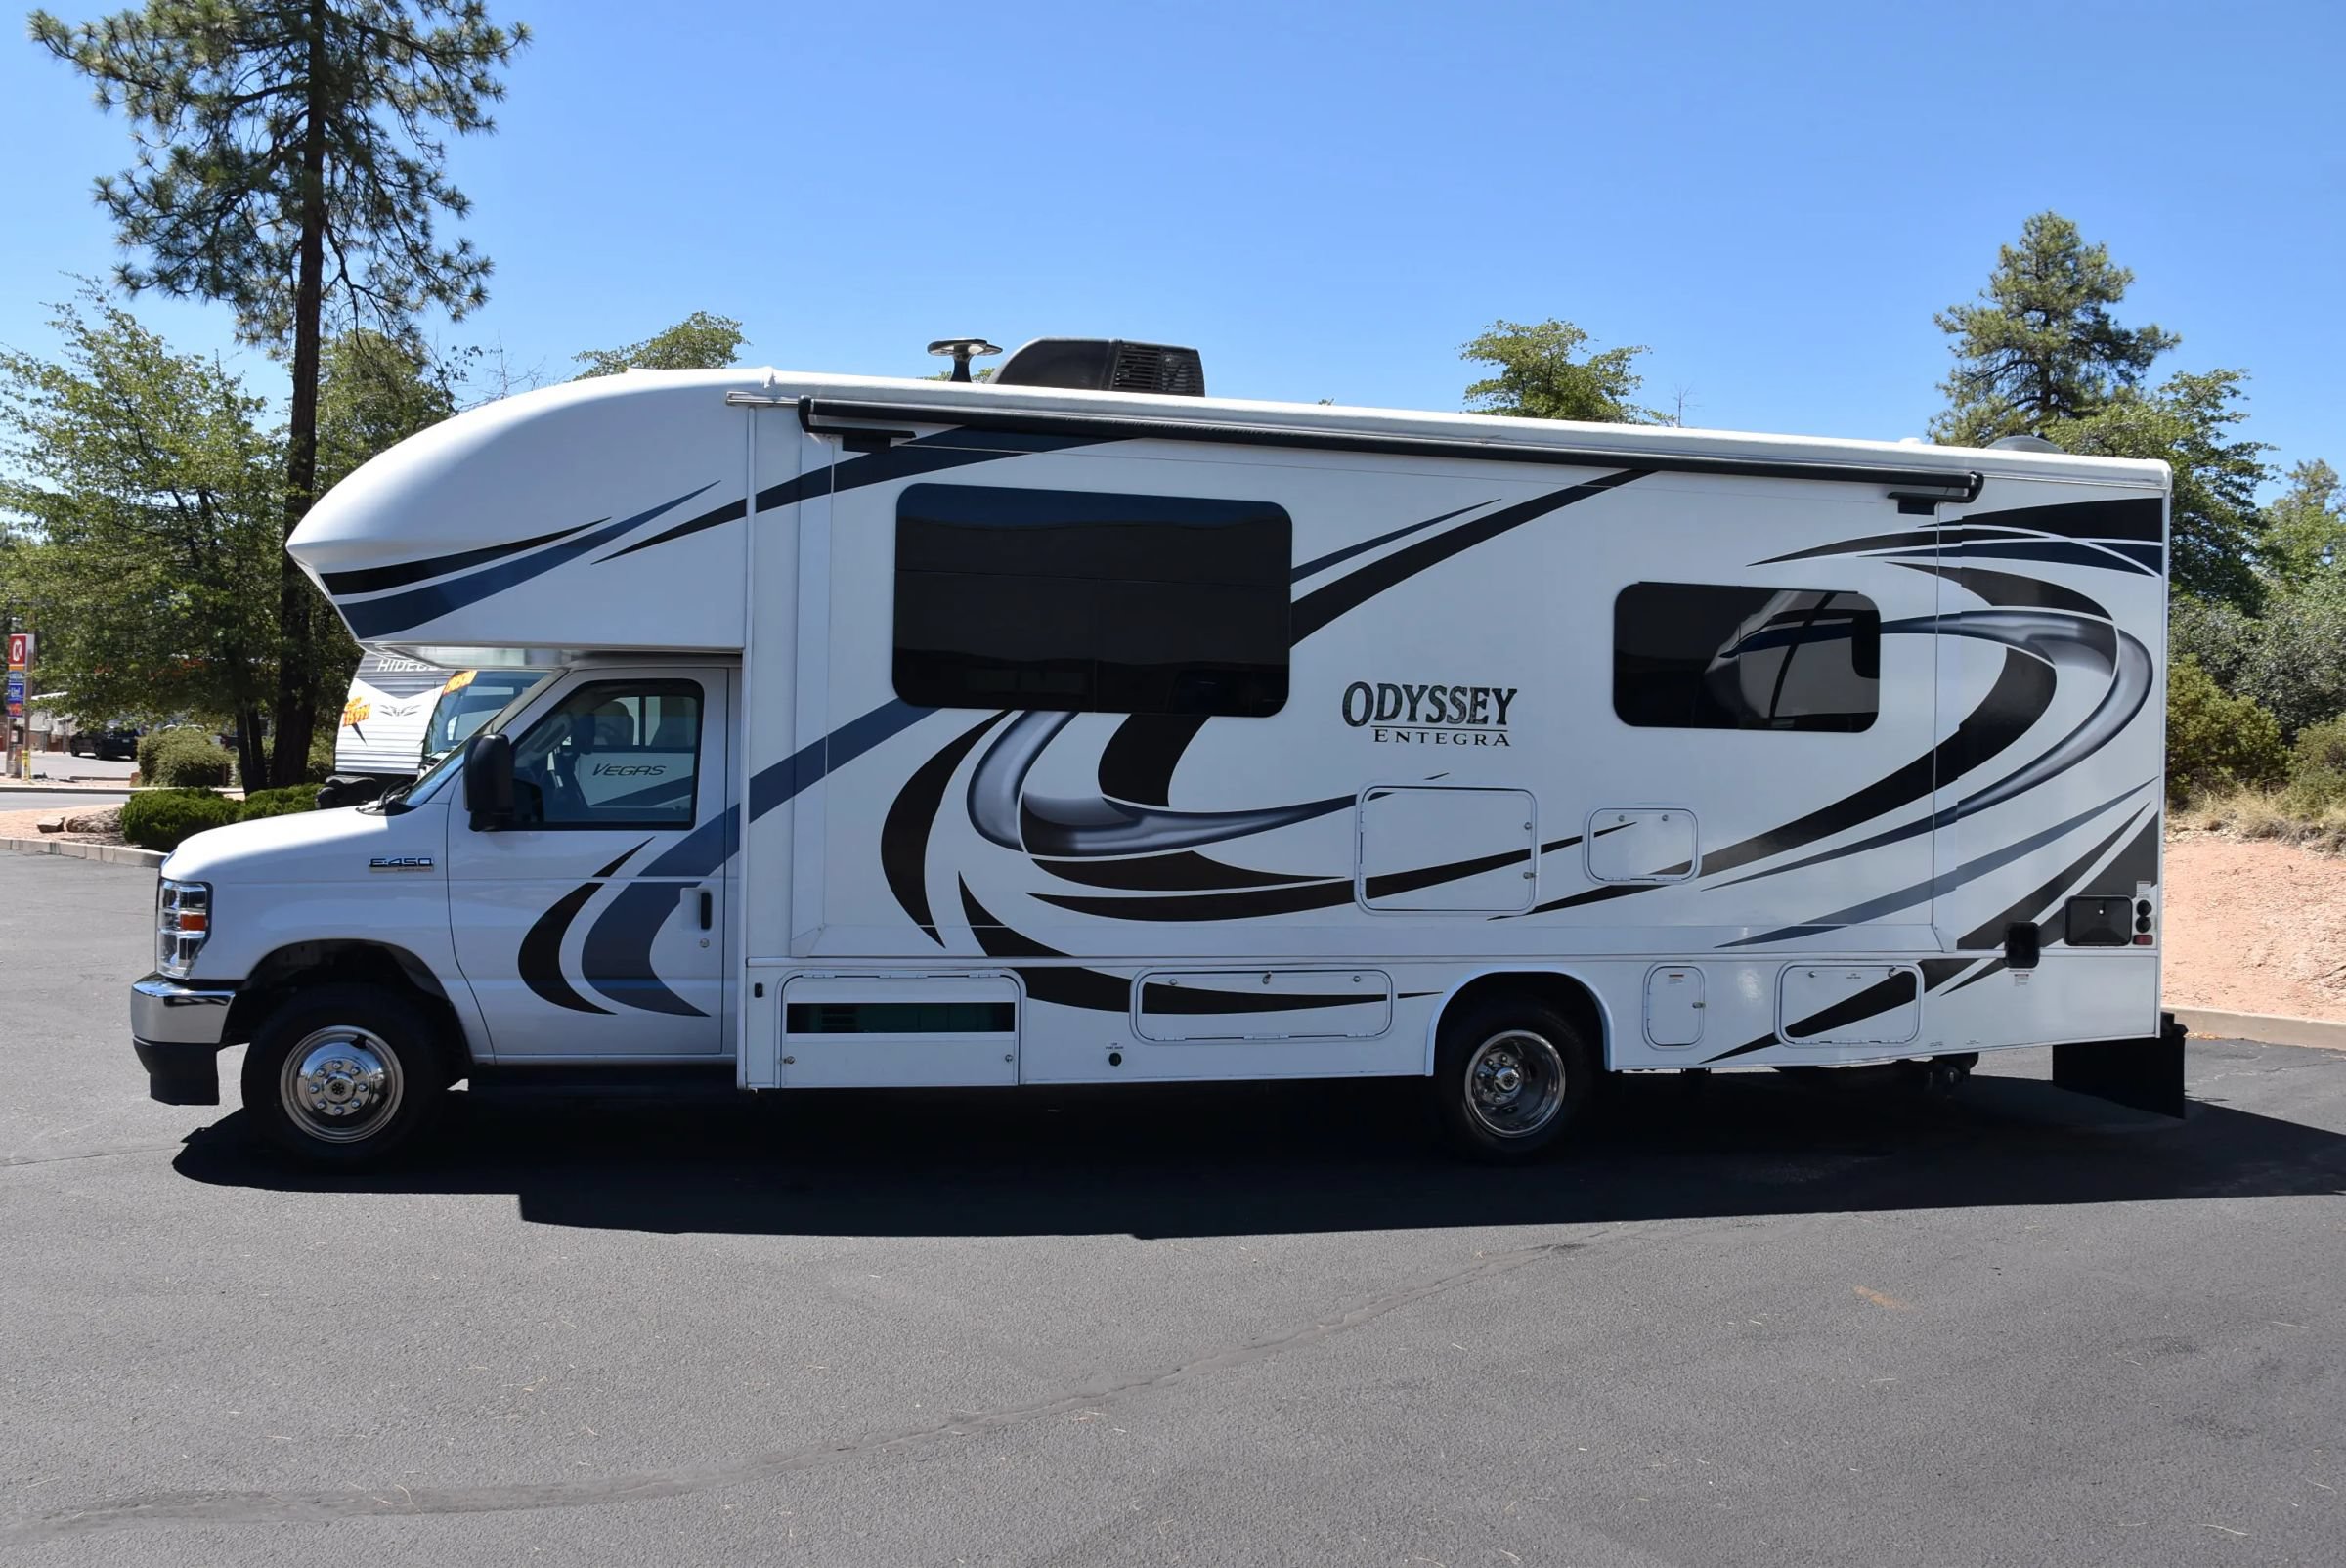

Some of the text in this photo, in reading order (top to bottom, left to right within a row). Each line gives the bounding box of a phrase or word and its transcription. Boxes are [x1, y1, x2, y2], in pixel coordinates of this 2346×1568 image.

[1342, 681, 1518, 728] ODYSSEY
[1373, 728, 1511, 747] ENTEGRA
[591, 763, 668, 777] VEGAS
[369, 857, 434, 868] E-450
